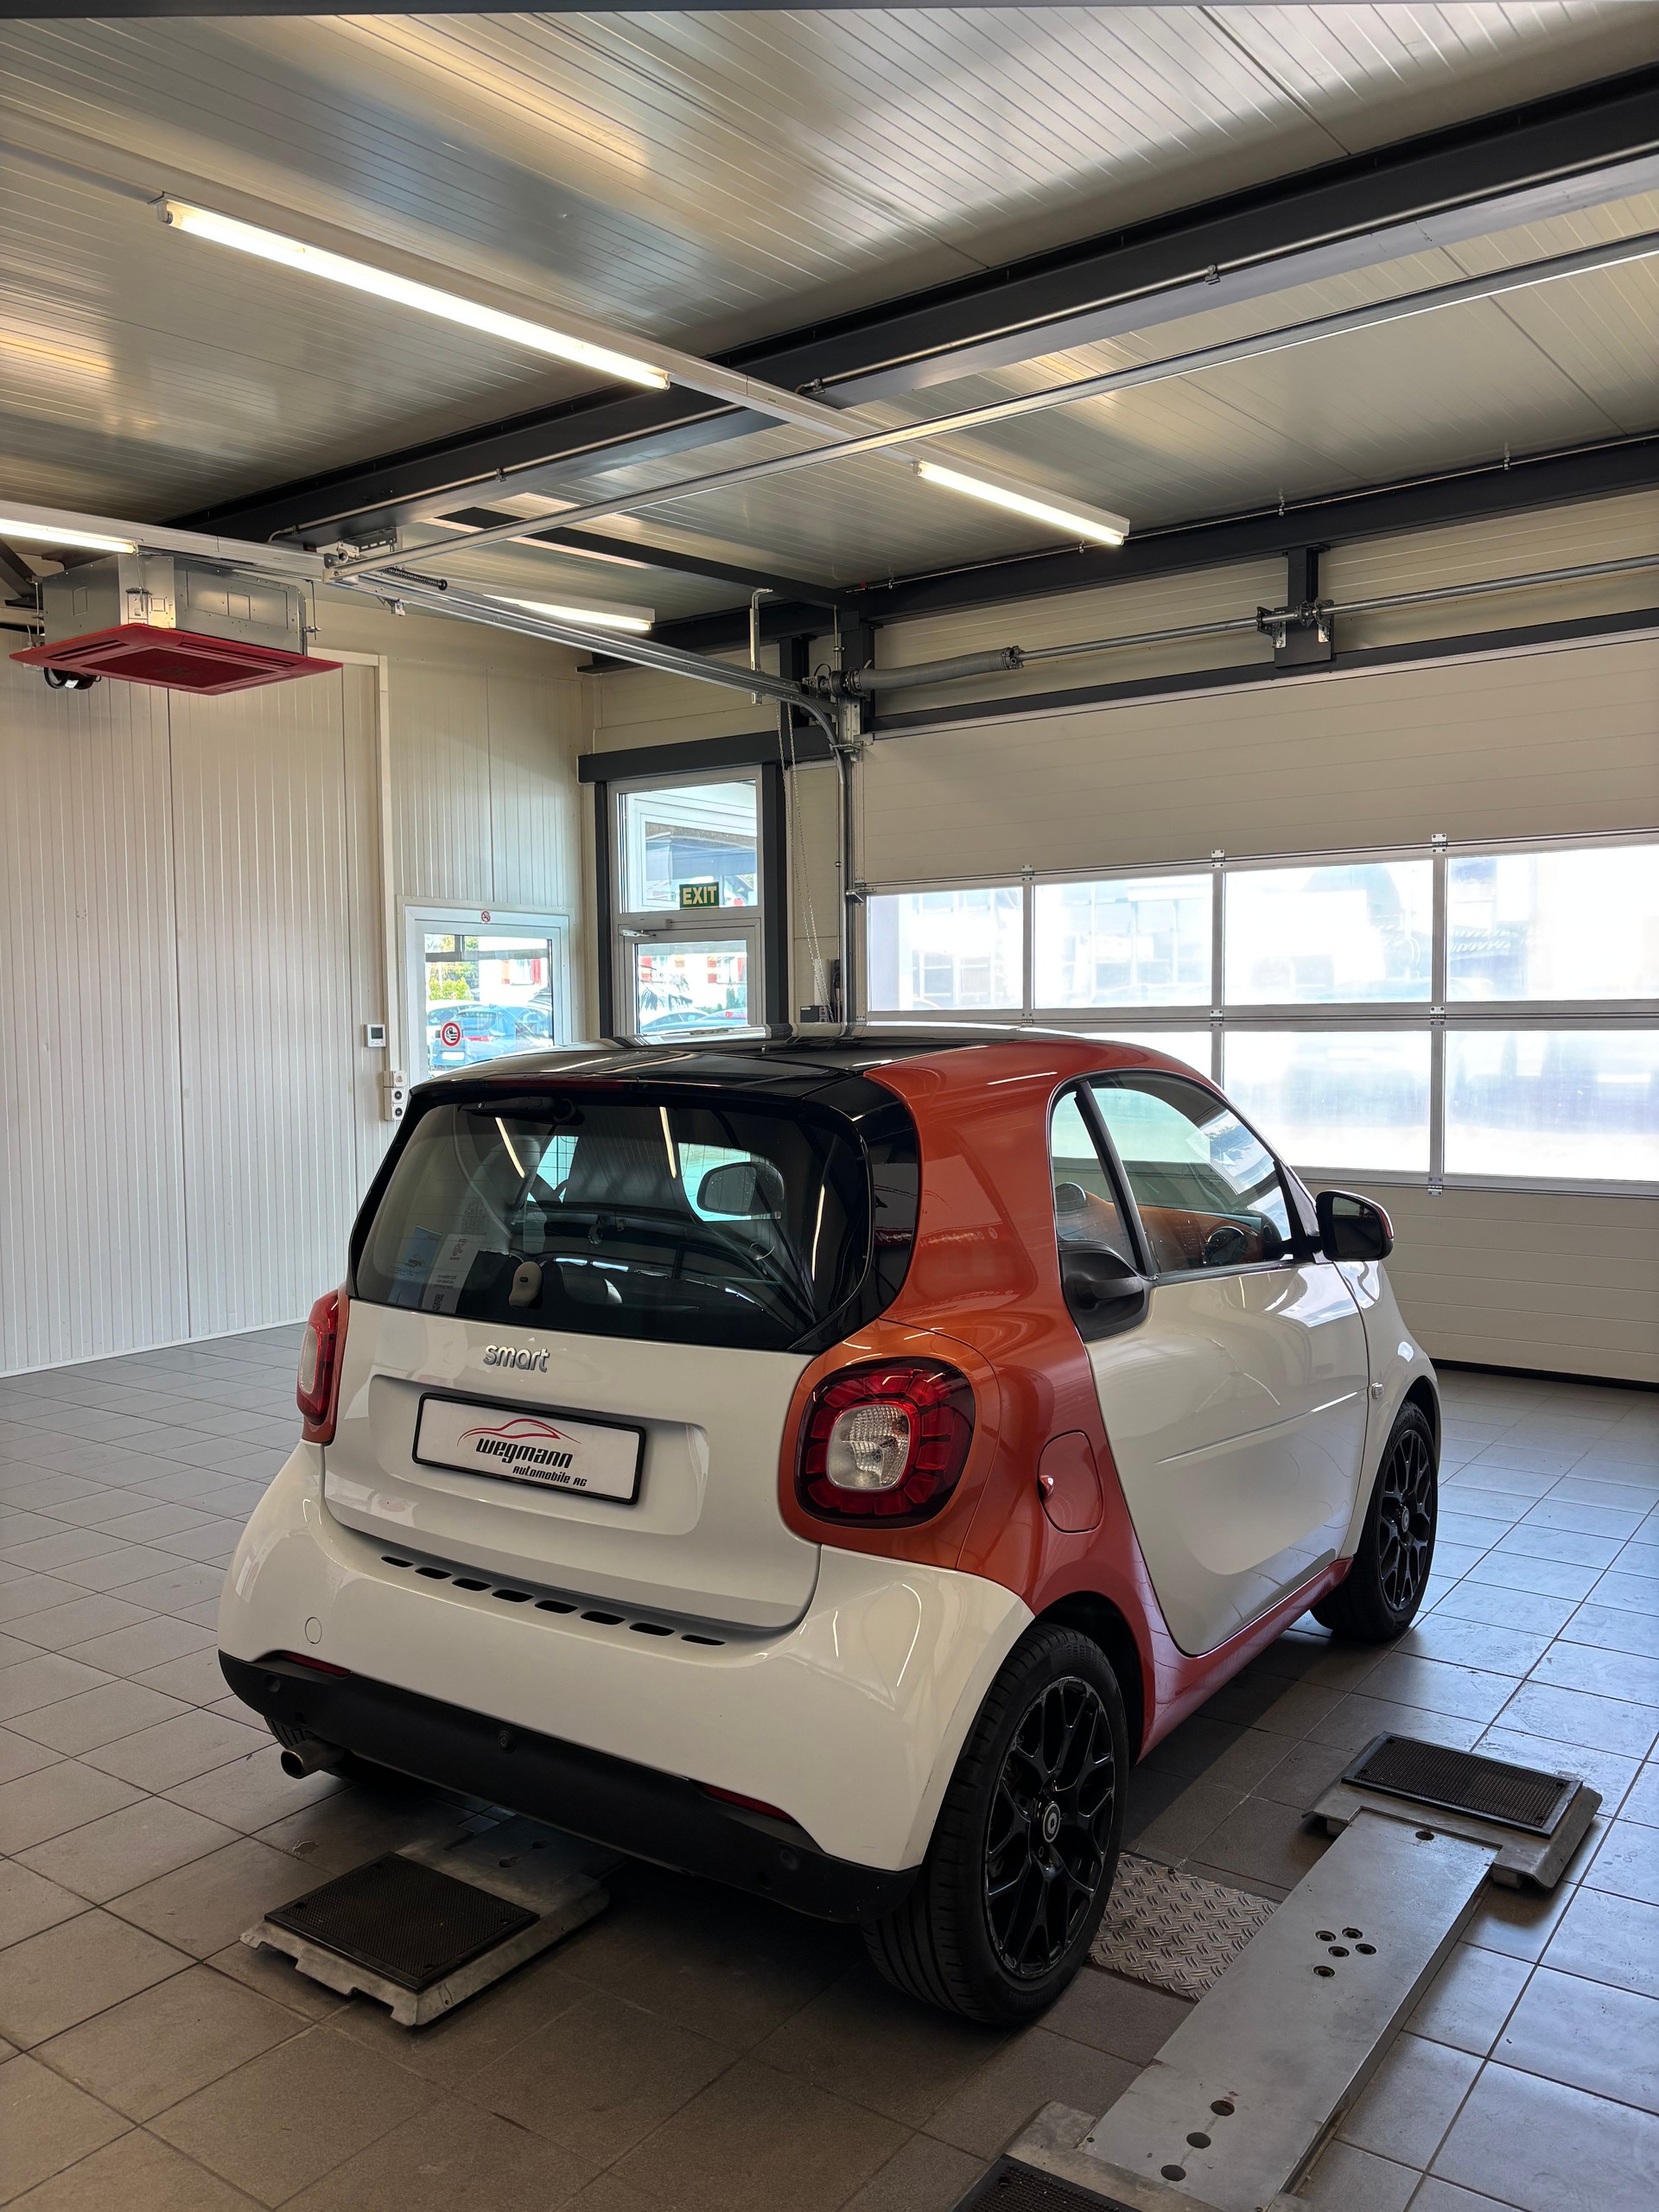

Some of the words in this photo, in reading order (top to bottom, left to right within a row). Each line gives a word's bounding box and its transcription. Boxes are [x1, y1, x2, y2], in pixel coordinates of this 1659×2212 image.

[683, 886, 717, 905] EXIT
[483, 1344, 550, 1373] smart
[476, 1438, 574, 1469] wegmann
[573, 1477, 588, 1487] AG
